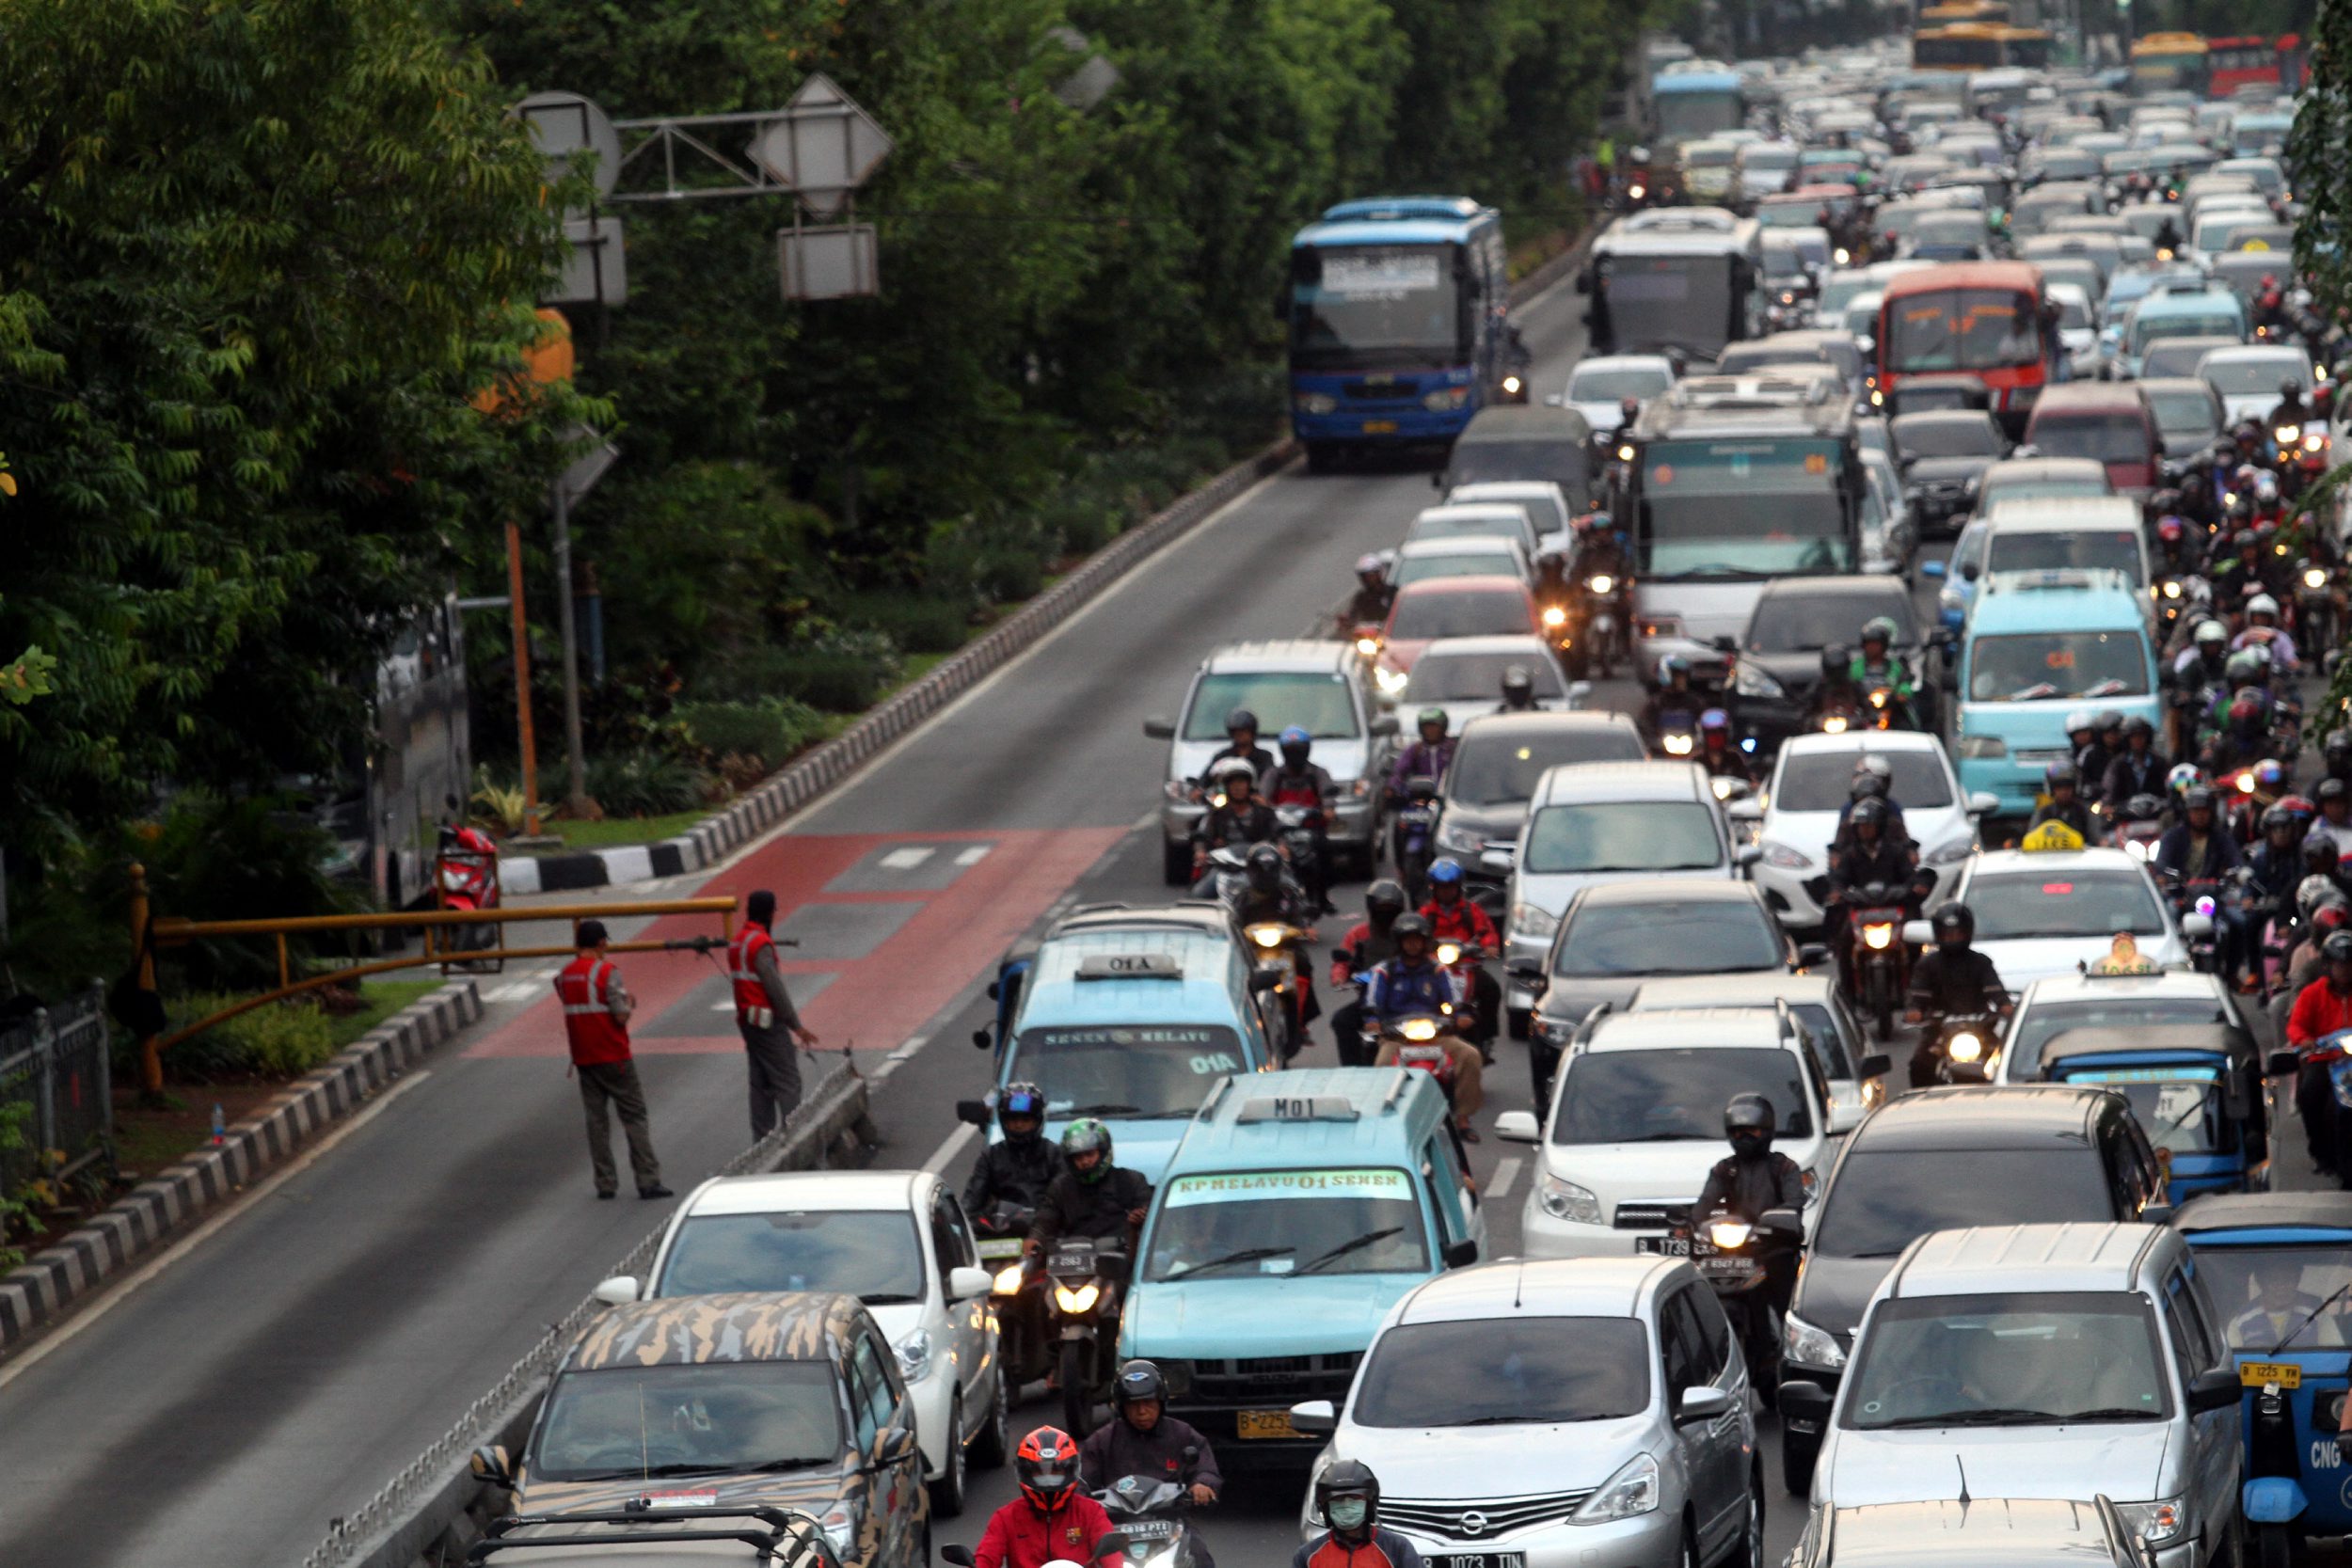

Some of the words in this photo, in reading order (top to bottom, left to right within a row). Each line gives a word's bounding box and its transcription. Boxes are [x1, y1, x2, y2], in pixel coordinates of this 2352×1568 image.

[1109, 957, 1152, 972] 01A
[1189, 1053, 1239, 1075] 01A
[1274, 1098, 1314, 1117] M01
[1659, 1239, 1690, 1256] 1739
[1241, 1414, 1249, 1430] B
[2311, 1439, 2342, 1469] CNG
[1449, 1554, 1486, 1568] 1073
[1496, 1552, 1523, 1568] TIN
